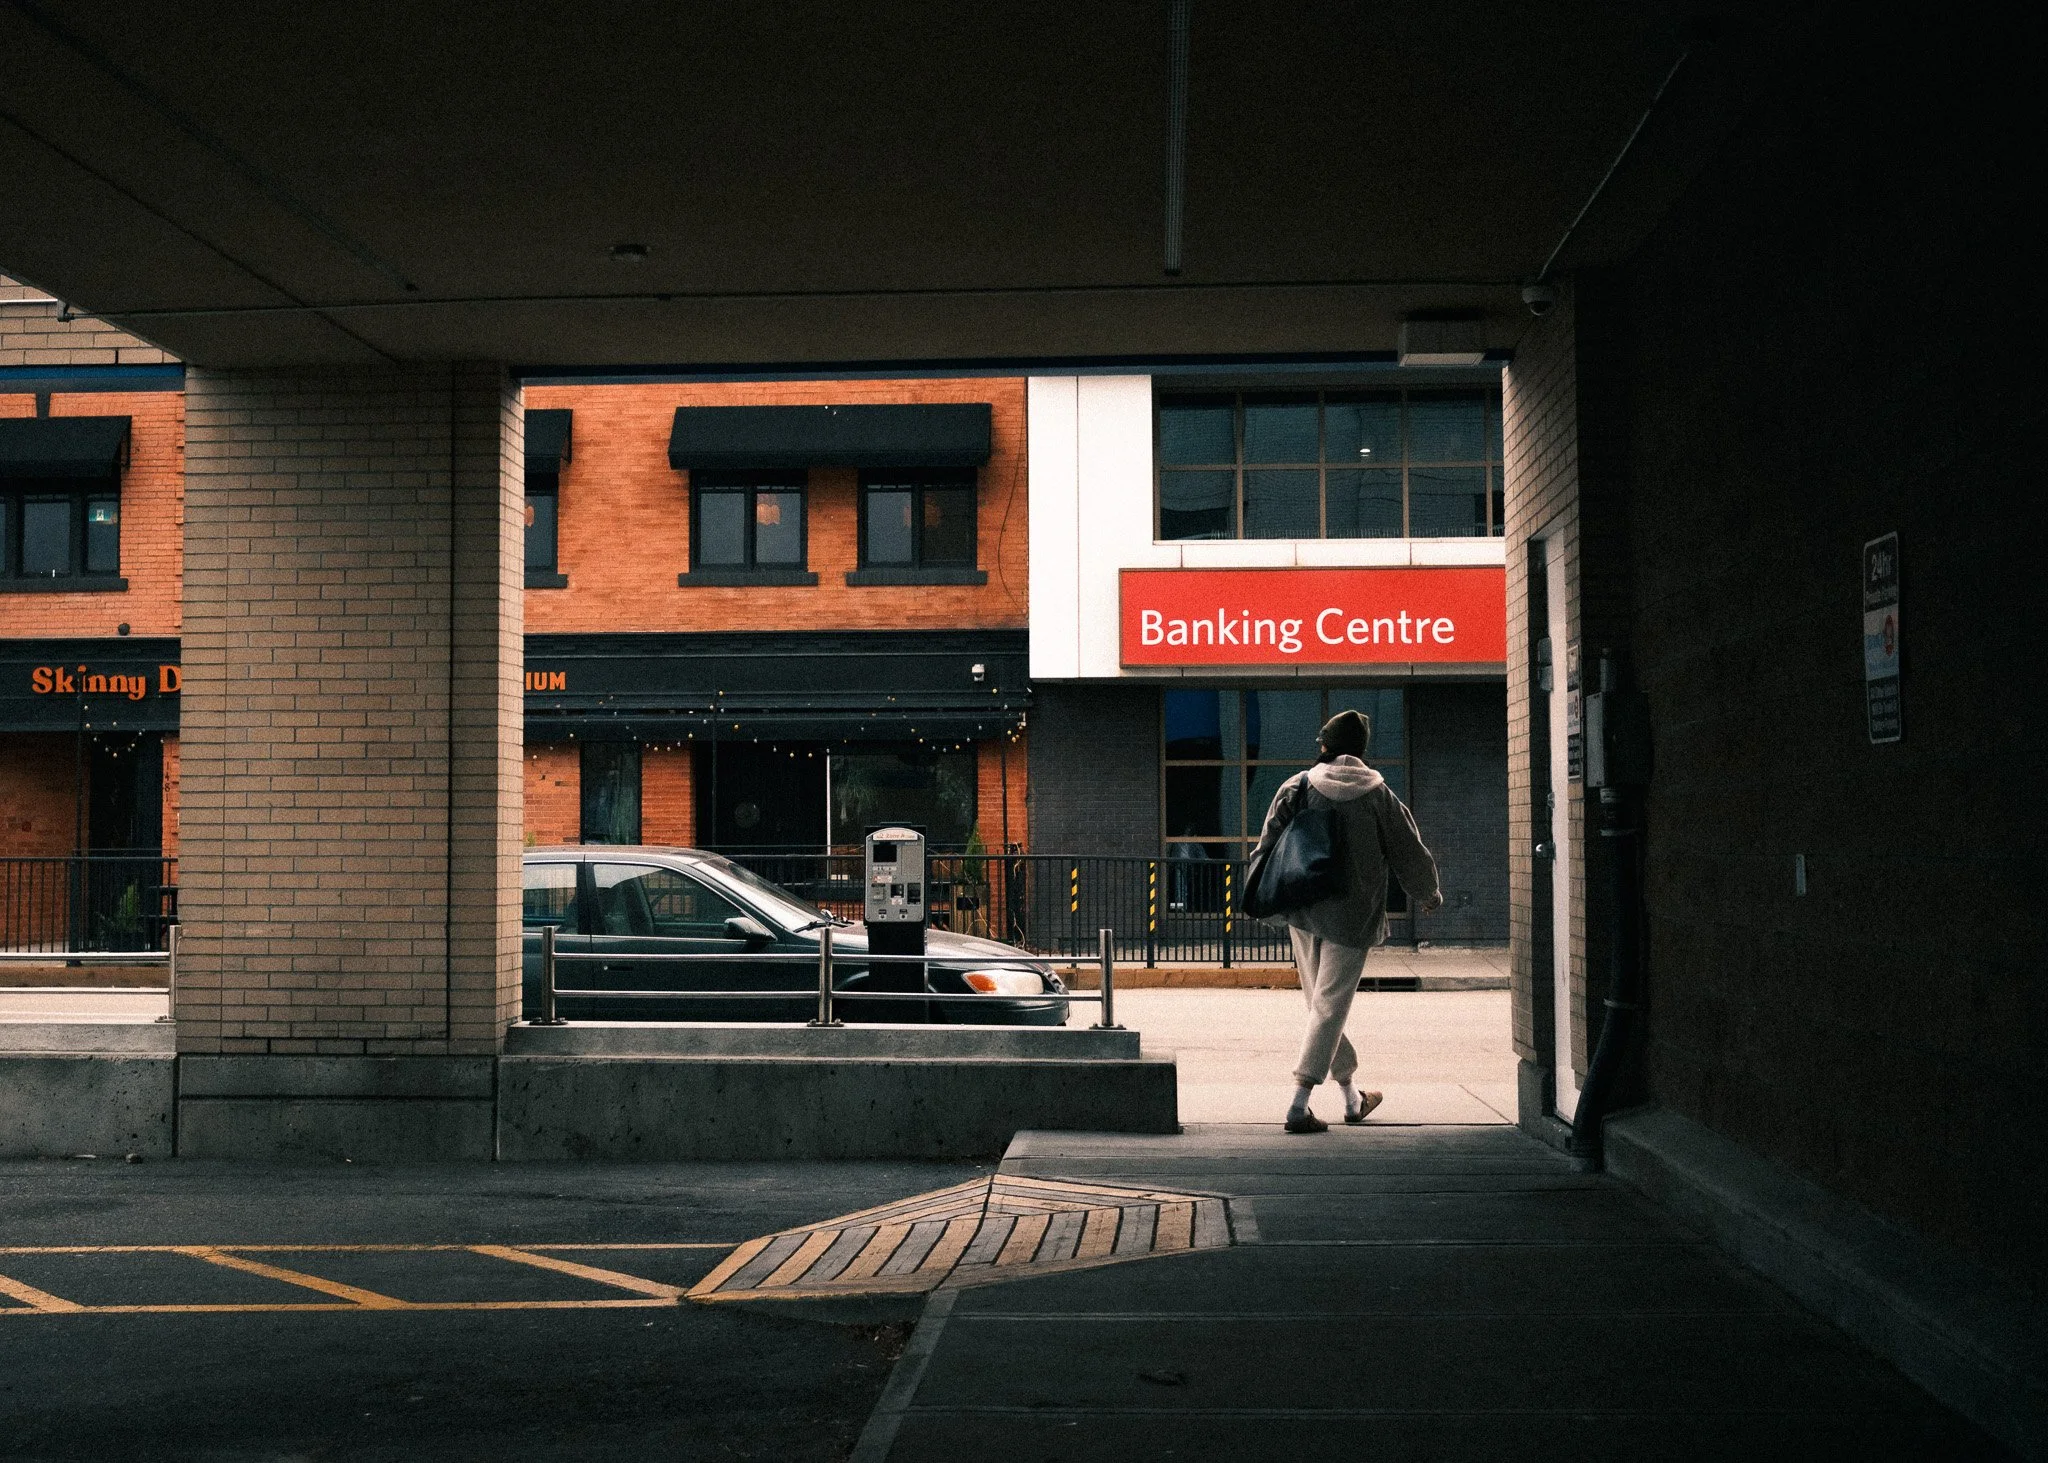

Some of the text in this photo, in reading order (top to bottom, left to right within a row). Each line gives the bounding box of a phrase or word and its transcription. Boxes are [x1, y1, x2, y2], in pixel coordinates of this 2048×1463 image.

[1140, 608, 1455, 654] Banking Centre
[31, 664, 146, 700] Skinny
[525, 671, 566, 691] IUM
